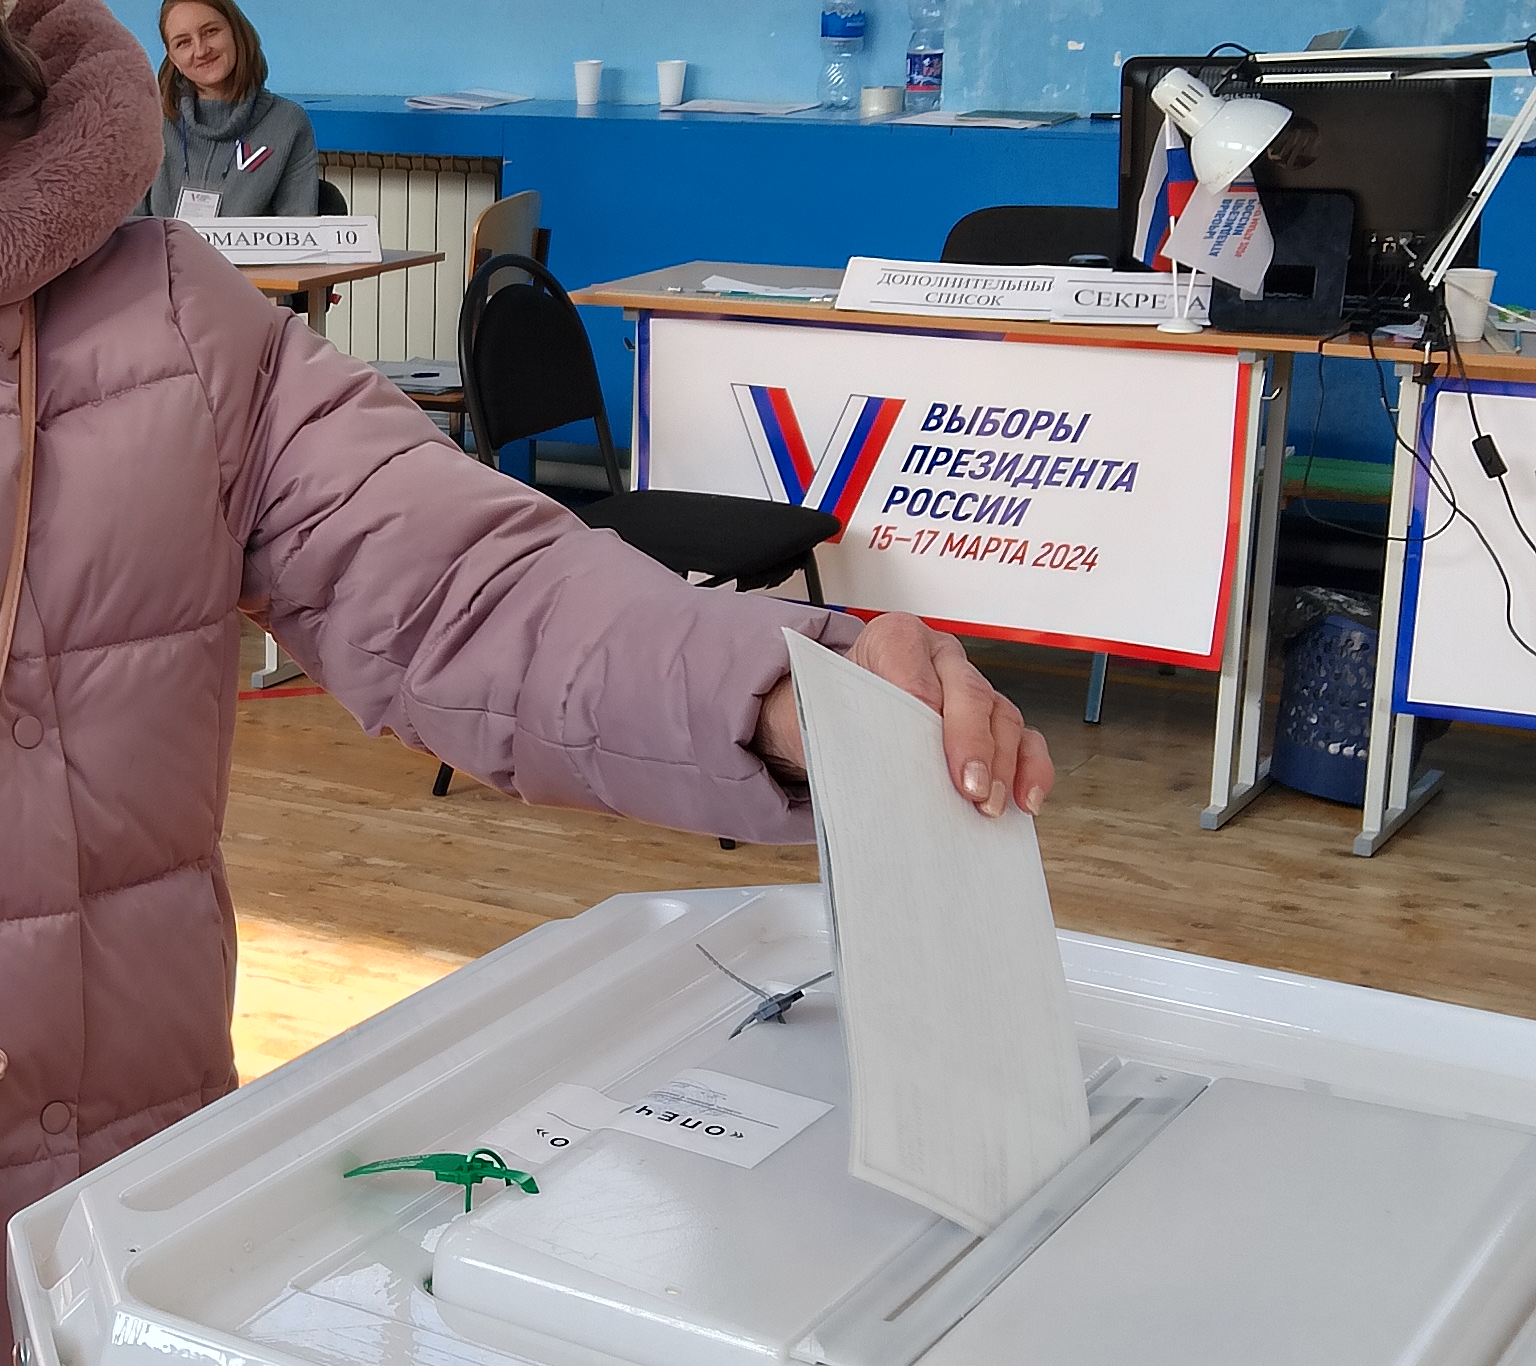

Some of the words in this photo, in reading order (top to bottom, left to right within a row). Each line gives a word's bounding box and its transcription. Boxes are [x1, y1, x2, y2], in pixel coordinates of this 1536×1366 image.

[199, 231, 319, 247] ОМАРОВА
[336, 230, 358, 245] 10
[924, 291, 1006, 307] СПИСОК
[920, 402, 1093, 444] ВЫБОРЫ
[900, 444, 1140, 493] ПРЕЗИДЕНТА
[882, 485, 1032, 527] РОССИИ
[943, 530, 1031, 566] МАРТА
[1031, 541, 1099, 573] 2024
